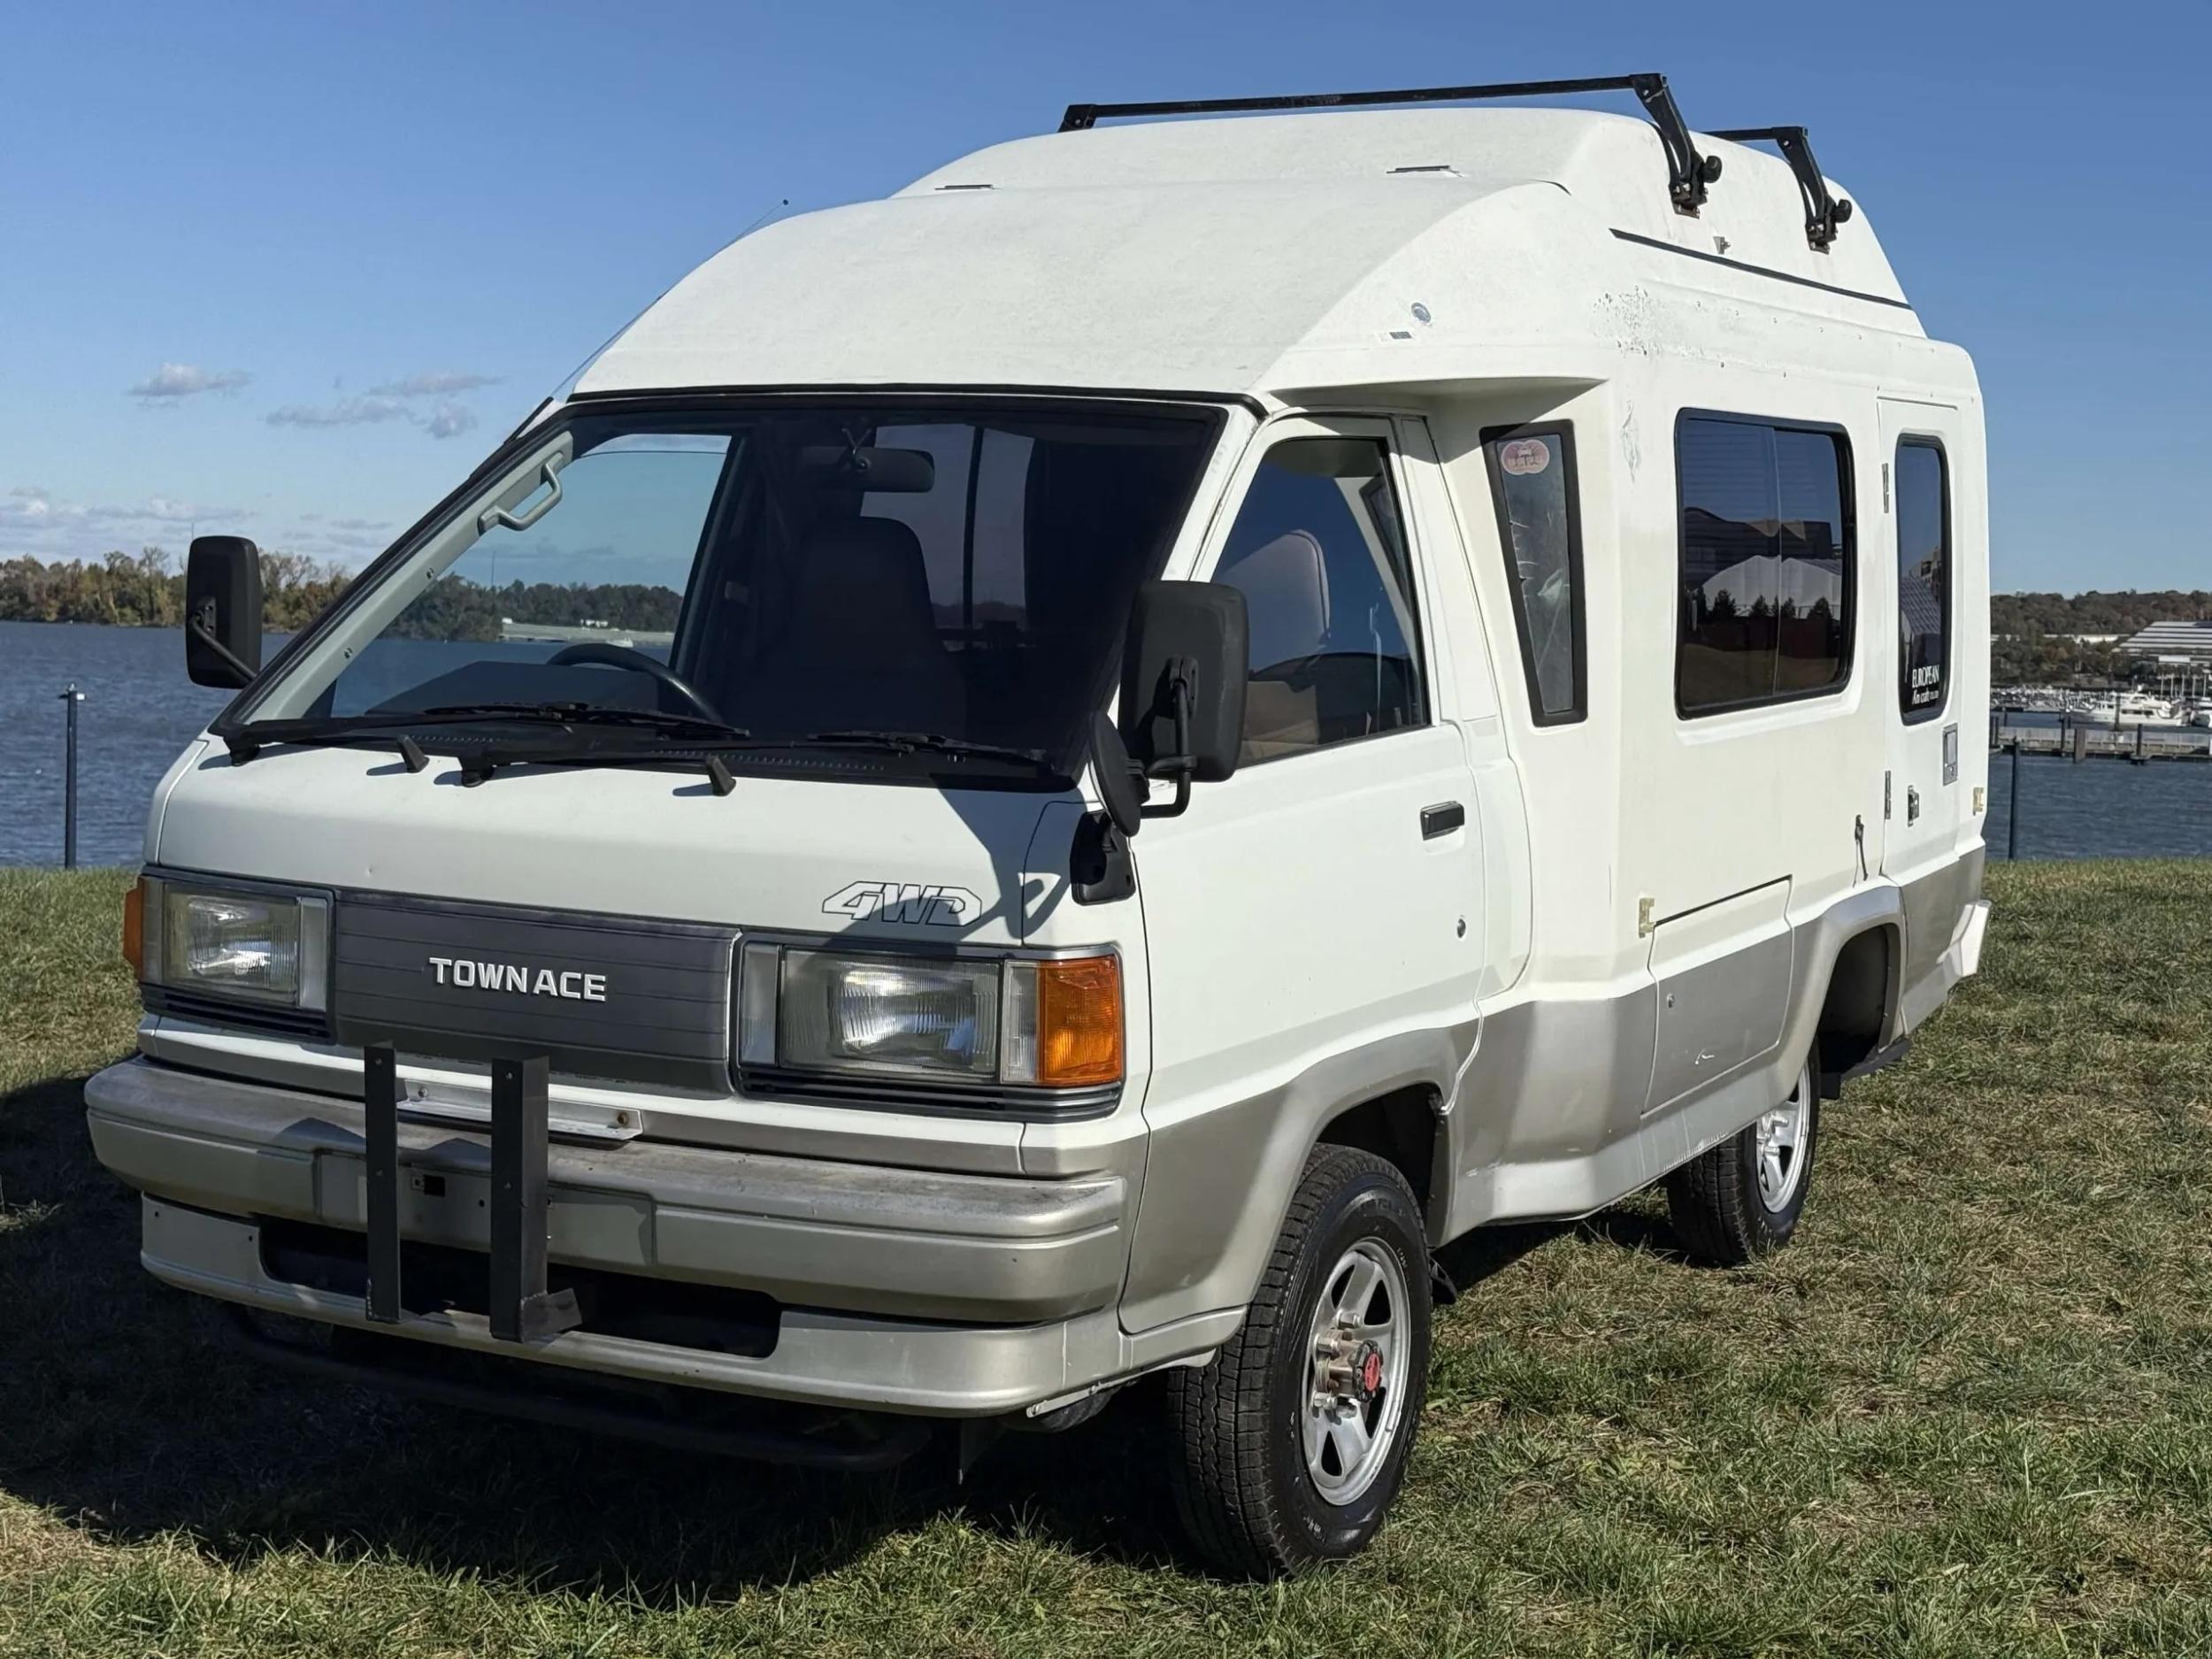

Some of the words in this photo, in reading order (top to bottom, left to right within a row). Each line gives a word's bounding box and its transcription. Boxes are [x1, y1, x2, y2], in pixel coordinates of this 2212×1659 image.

[1912, 664, 1939, 688] EUROPEAN
[822, 880, 982, 926] 4WD
[429, 956, 527, 993] TOWN
[533, 969, 607, 1002] ACE
